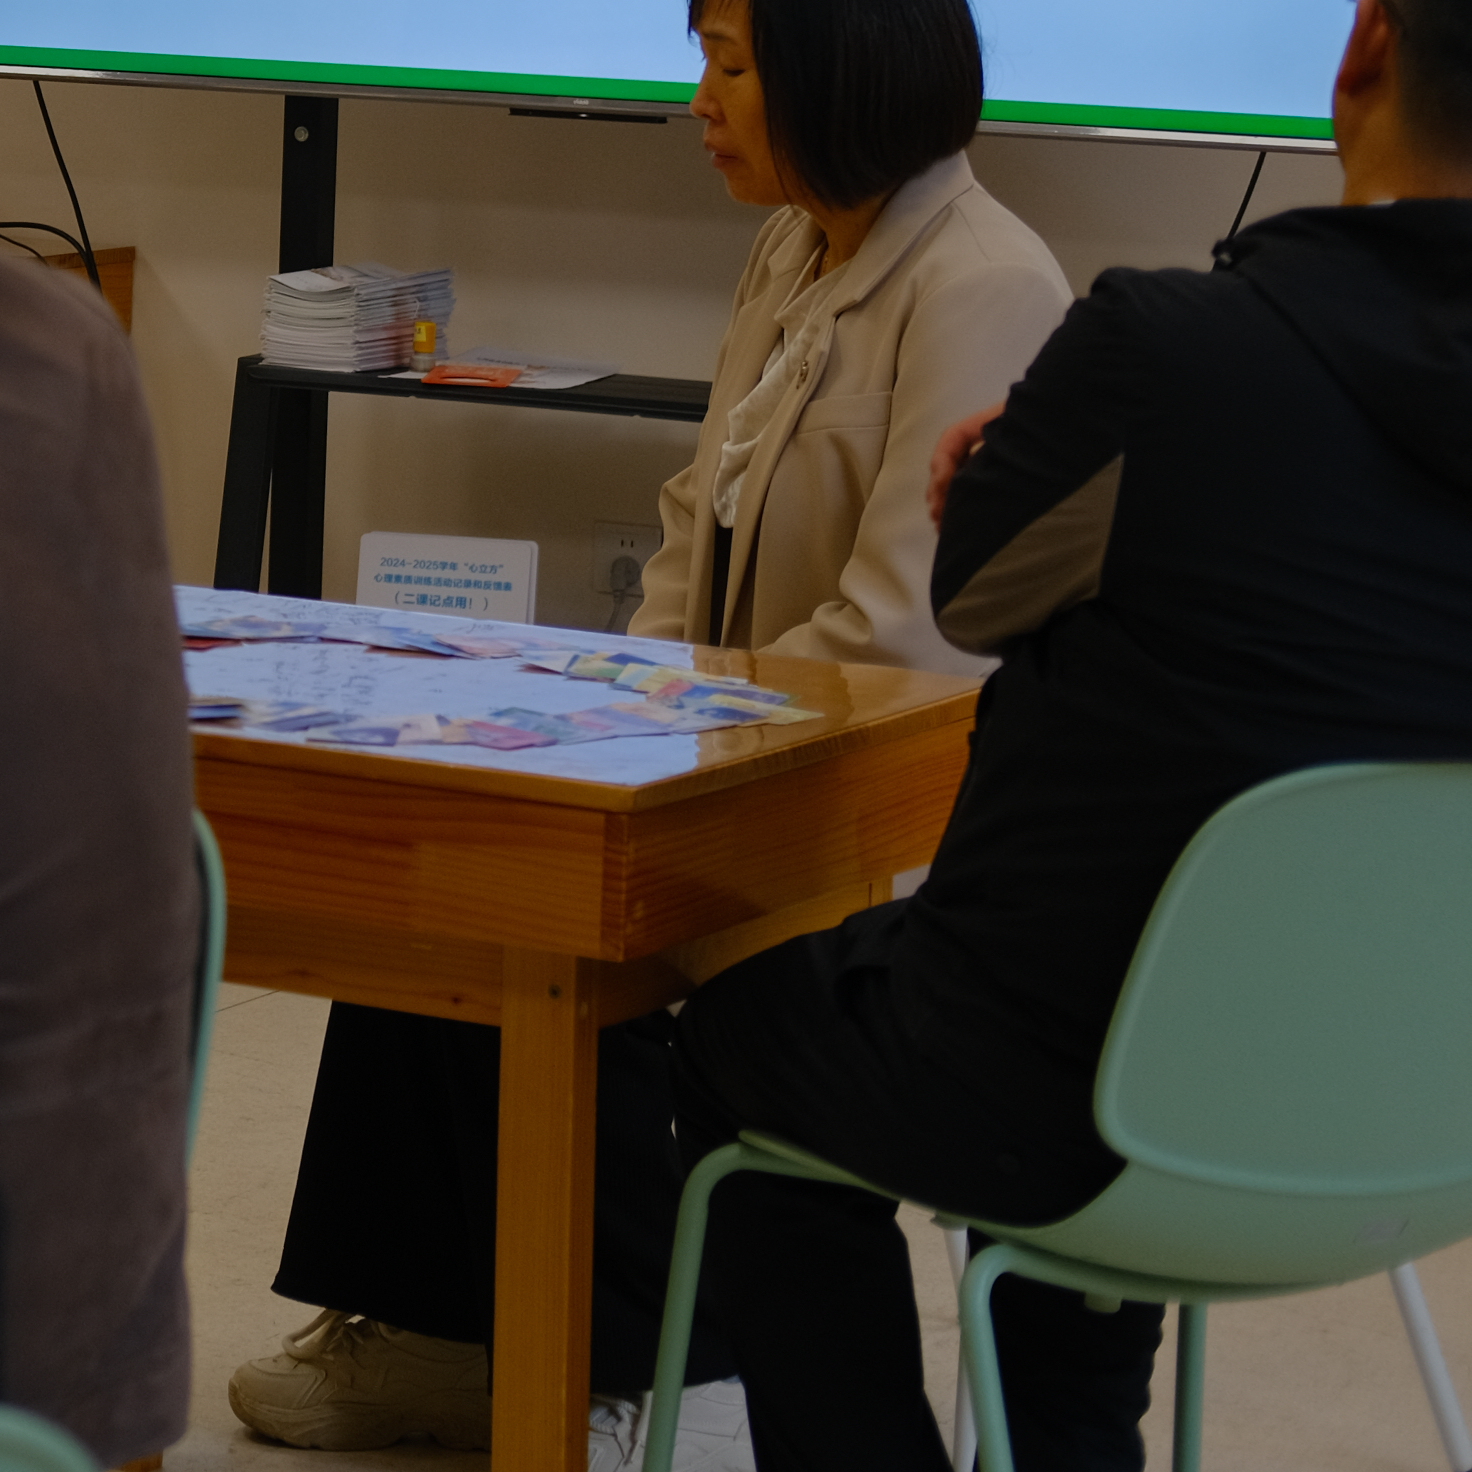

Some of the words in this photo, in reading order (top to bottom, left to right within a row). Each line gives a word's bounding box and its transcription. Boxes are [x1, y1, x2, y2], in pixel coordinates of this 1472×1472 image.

[373, 573, 512, 592] 心理素质训练活动记录和反馈表
